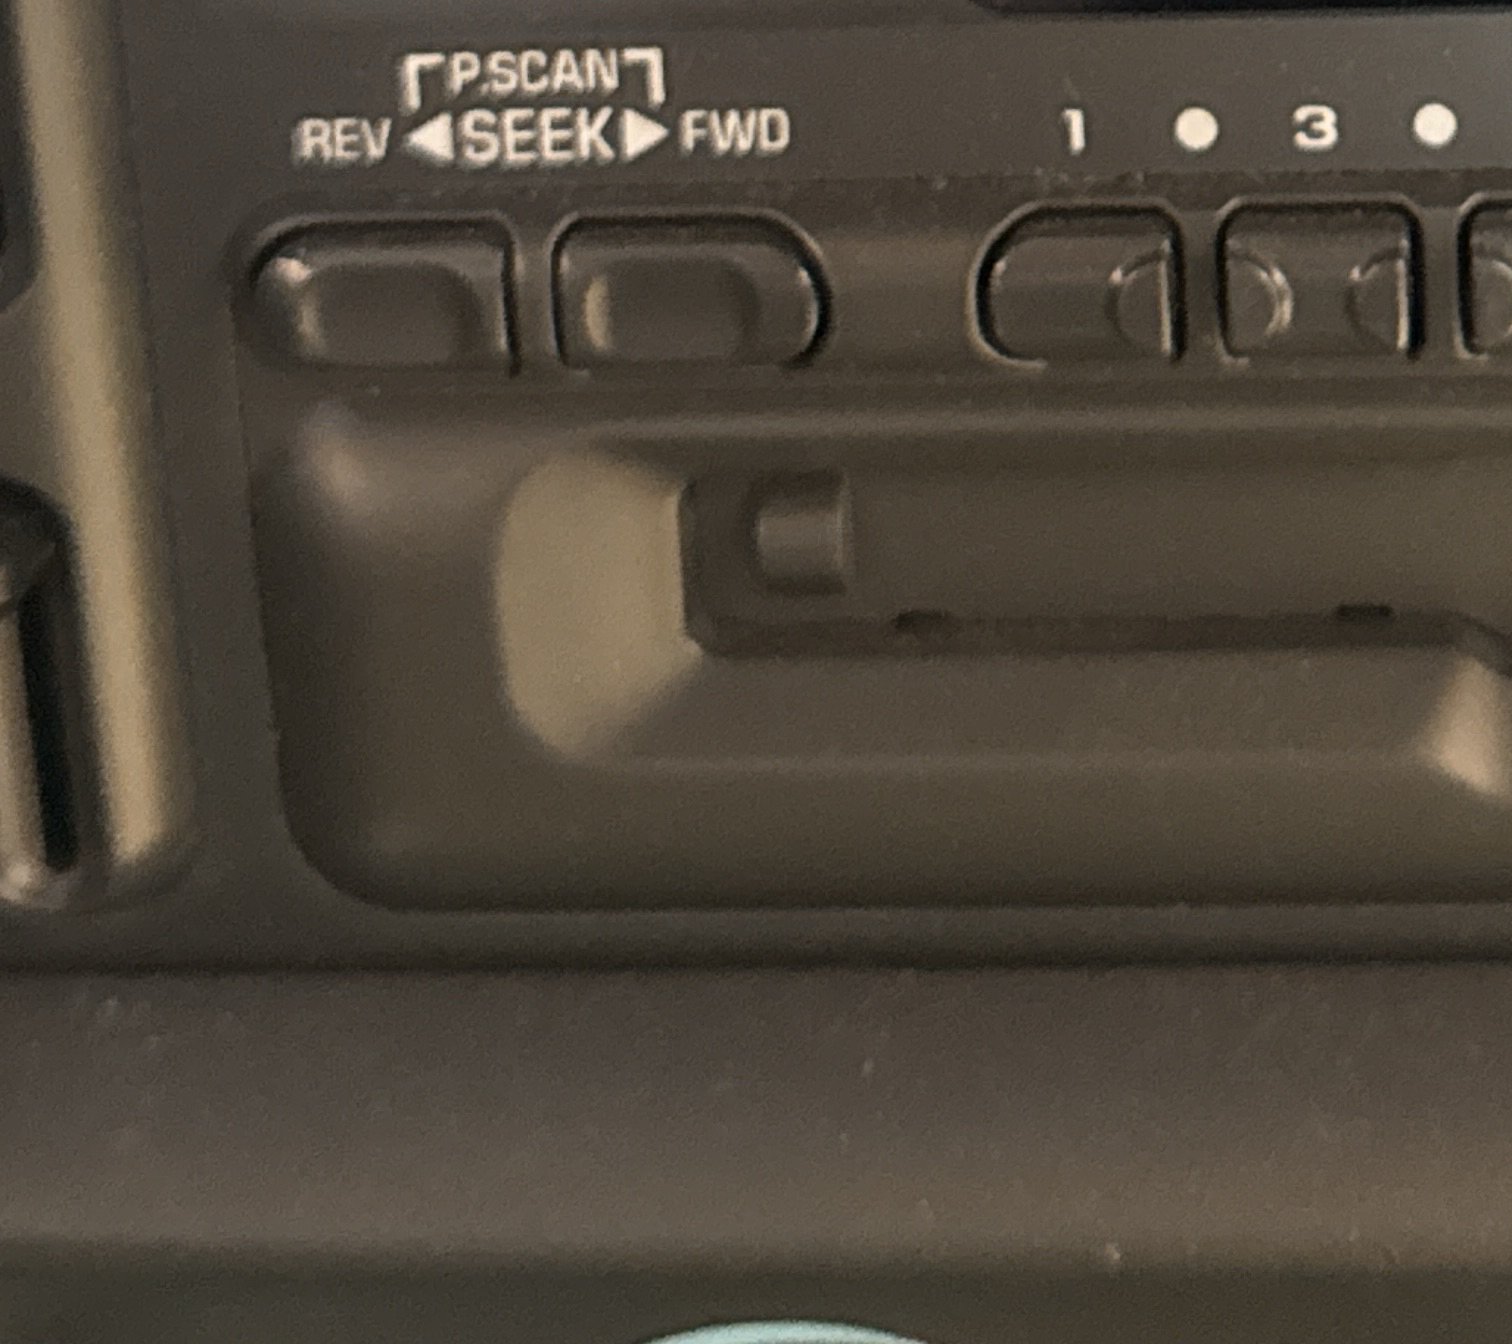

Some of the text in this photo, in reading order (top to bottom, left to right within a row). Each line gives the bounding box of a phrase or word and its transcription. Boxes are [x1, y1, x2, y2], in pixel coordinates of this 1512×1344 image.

[295, 105, 791, 168] REV SEEK FWD
[1062, 108, 1087, 154] 1
[1291, 104, 1339, 151] 3
